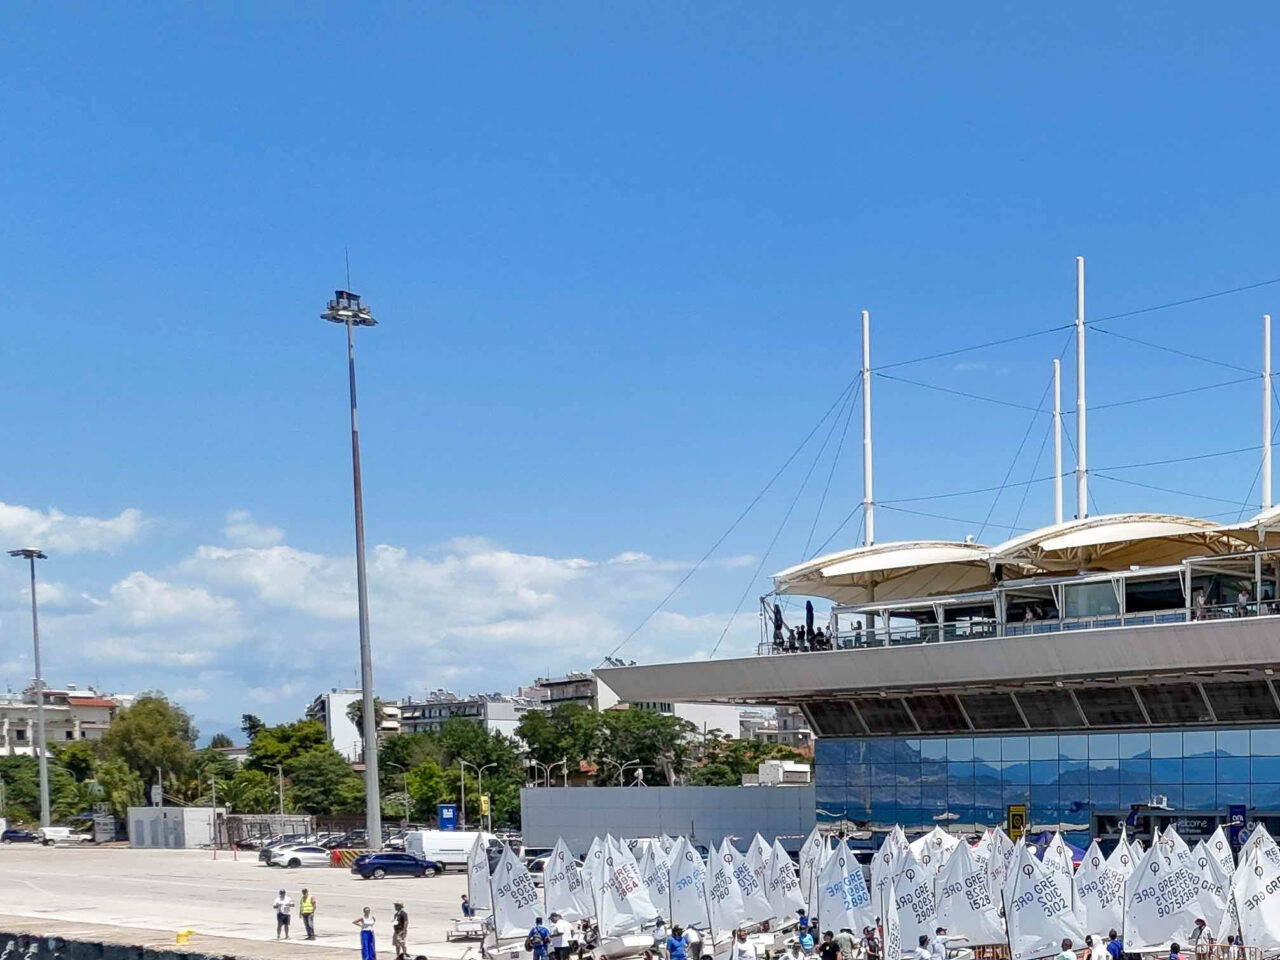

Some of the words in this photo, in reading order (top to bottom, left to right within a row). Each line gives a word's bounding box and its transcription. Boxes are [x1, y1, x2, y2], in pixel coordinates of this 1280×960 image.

[1177, 850, 1189, 861] RE
[1265, 847, 1277, 858] RE
[565, 861, 576, 874] RE
[657, 861, 668, 873] RE
[733, 862, 749, 878] GRE
[779, 863, 791, 877] RE
[513, 872, 531, 887] GRE
[715, 868, 725, 883] RE
[844, 870, 863, 886] GRE
[965, 873, 983, 888] GRE
[743, 880, 758, 896] 270
[914, 882, 929, 898] GRE
[1034, 876, 1056, 894] GRE
[1201, 880, 1224, 896] GRE
[515, 891, 538, 908] 2309
[844, 892, 868, 911] 2890
[969, 895, 991, 911] 1528
[1044, 898, 1068, 917] 3102
[916, 905, 934, 924] 2909
